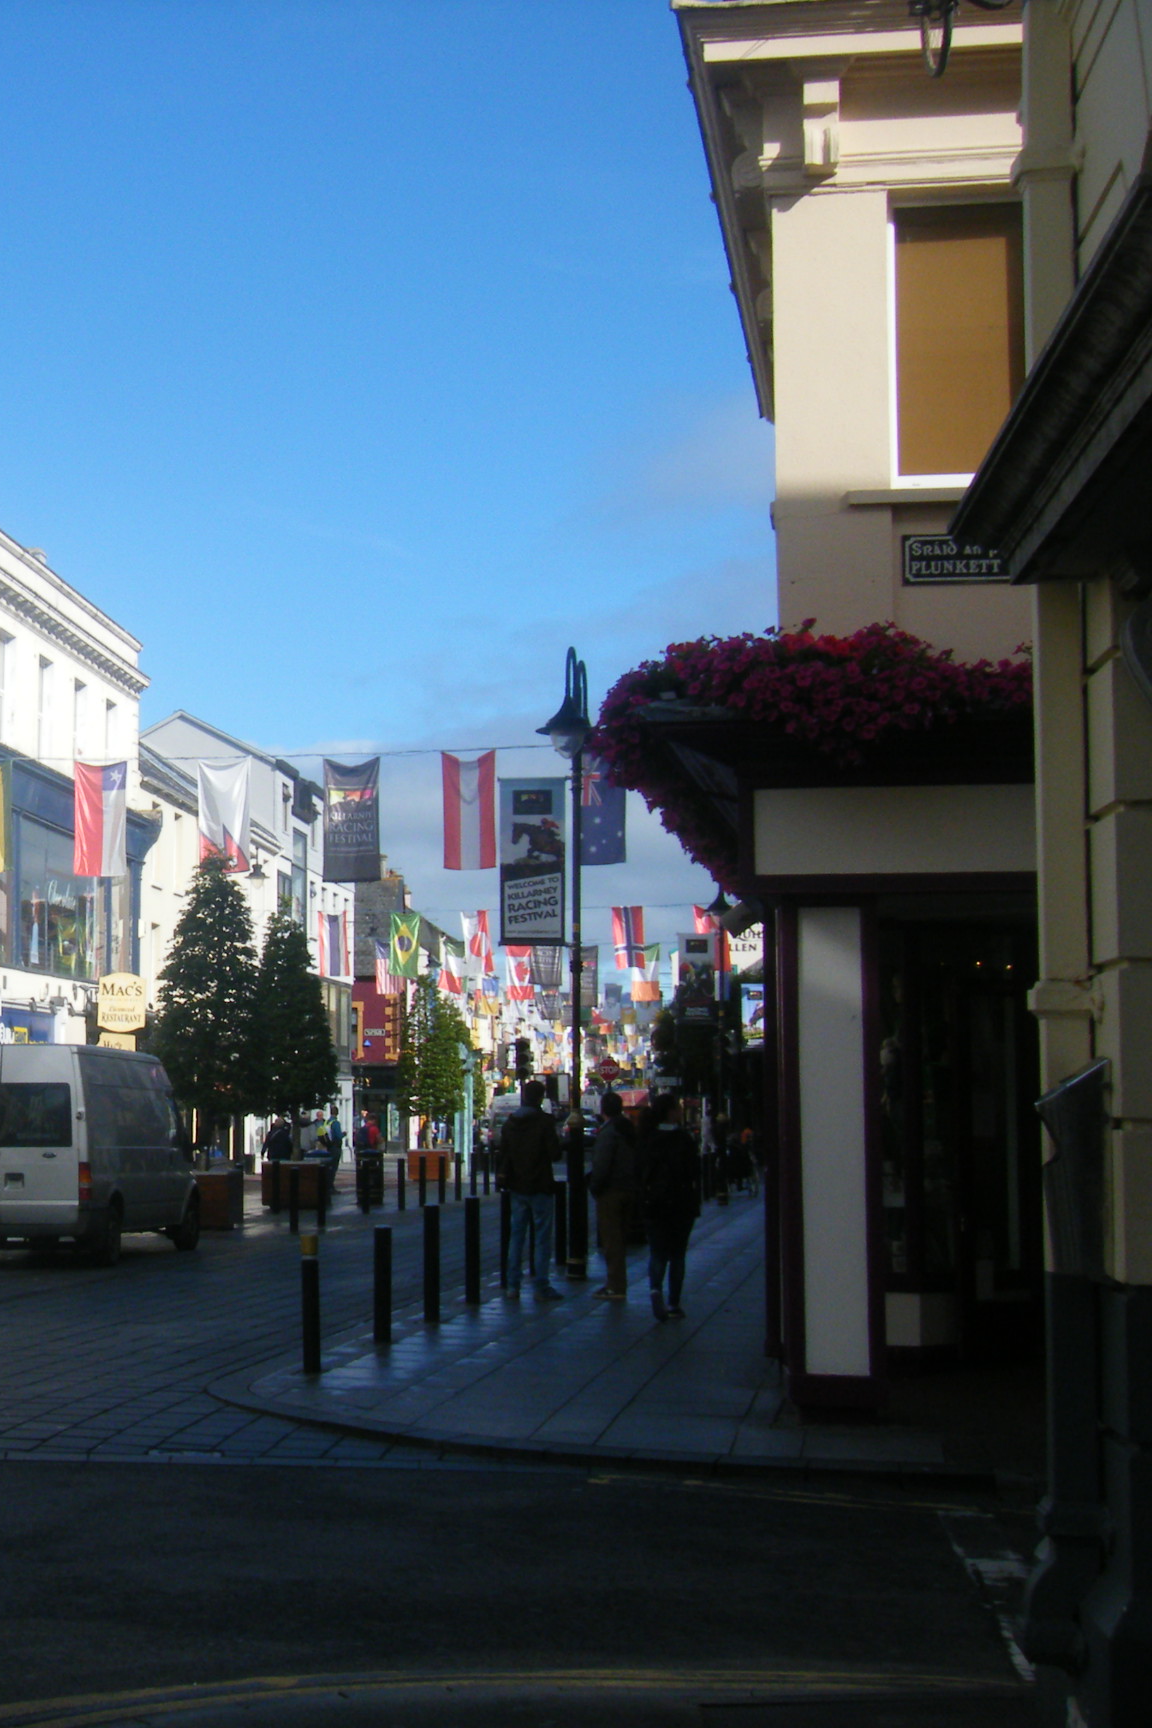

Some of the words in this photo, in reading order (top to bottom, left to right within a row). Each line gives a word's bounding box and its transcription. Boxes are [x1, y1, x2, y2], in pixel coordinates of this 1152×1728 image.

[911, 559, 1001, 575] PLUNKETT
[329, 822, 374, 833] RACING
[329, 833, 373, 844] FESTIVAL
[507, 879, 545, 890] WELCOME
[547, 876, 559, 884] TO
[507, 886, 558, 901] KILLARNEY
[508, 896, 559, 913] RACING
[508, 909, 559, 925] FESTIVAL
[101, 1012, 142, 1024] RESTAURANT
[600, 1066, 619, 1075] STOP
